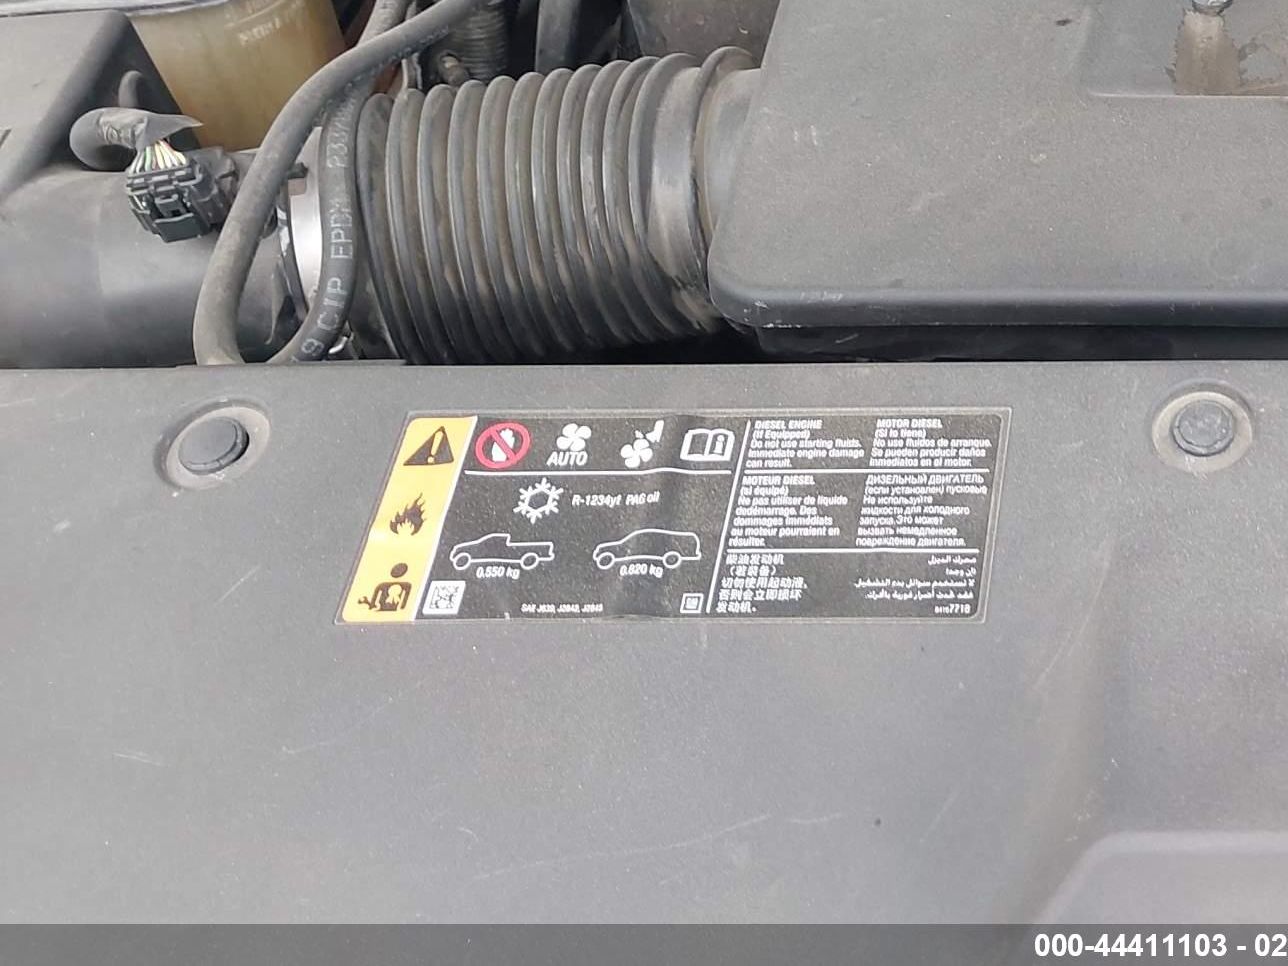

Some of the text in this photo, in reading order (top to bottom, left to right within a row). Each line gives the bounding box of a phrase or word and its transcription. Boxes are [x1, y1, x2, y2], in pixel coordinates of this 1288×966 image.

[754, 419, 823, 429] DIESEL ENGINE
[876, 418, 943, 428] MOTOR DIESEL
[750, 439, 762, 448] Do
[764, 439, 779, 448] not
[781, 440, 797, 448] use
[798, 439, 833, 449] starting
[873, 439, 885, 448] No
[937, 439, 949, 447] de
[797, 449, 827, 459] engine
[828, 448, 864, 458] damage
[871, 448, 883, 457] Se
[884, 448, 918, 458] pueden
[920, 448, 957, 458] producir
[546, 451, 588, 466] AUTO
[746, 459, 762, 468] can
[920, 459, 932, 467] en
[933, 458, 942, 467] el
[741, 475, 815, 485] MOTEUR DIESEL
[928, 474, 984, 485] ДВИГАТЕЛЬ
[647, 490, 660, 503] oil
[738, 495, 848, 507] Ne pas utiliser de liquide
[799, 506, 817, 515] Des
[733, 516, 783, 527] dommages
[731, 526, 840, 538] au moteur pourraient en
[476, 565, 520, 580] 0.550 kg
[649, 563, 664, 578] kg
